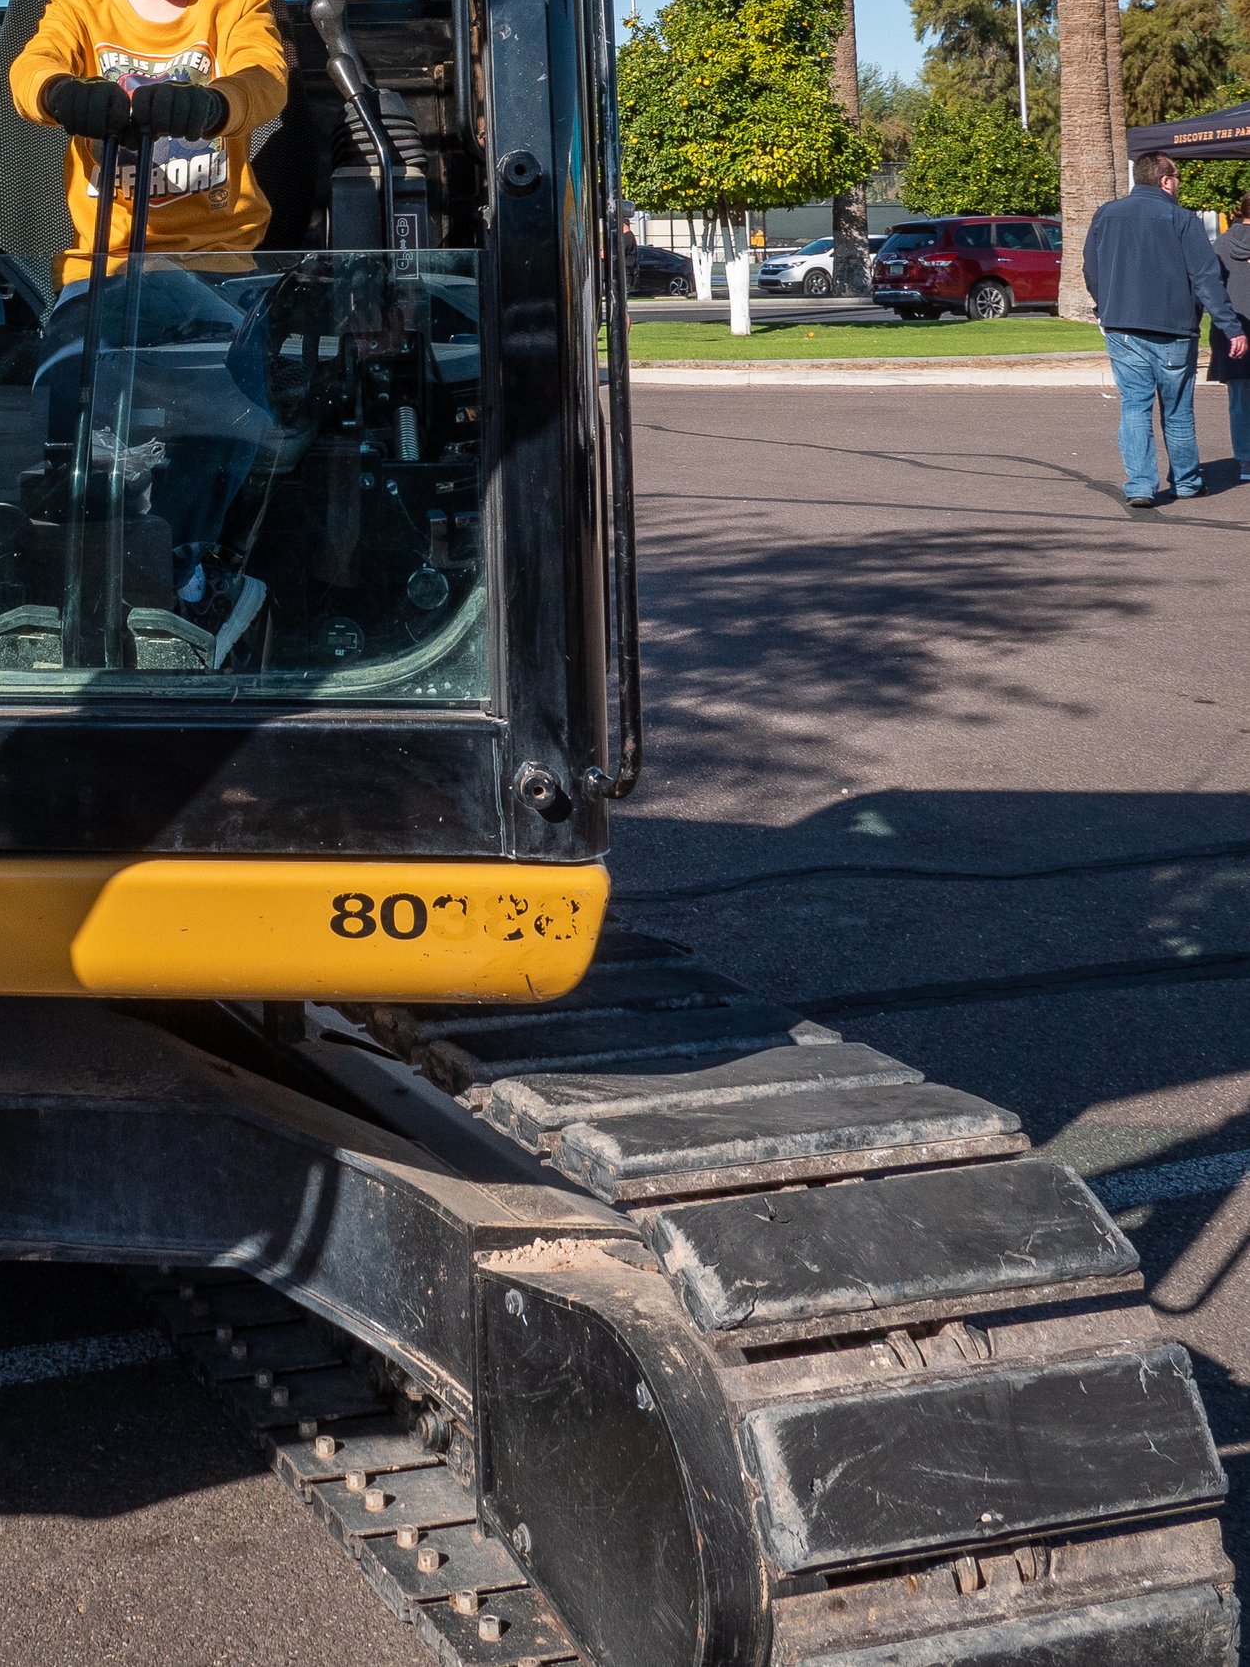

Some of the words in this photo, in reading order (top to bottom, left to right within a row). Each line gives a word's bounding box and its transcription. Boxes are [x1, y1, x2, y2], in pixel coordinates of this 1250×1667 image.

[99, 52, 129, 73] LIFE
[133, 59, 149, 71] IS
[1173, 131, 1214, 143] DISCOVER
[1216, 129, 1233, 139] THE
